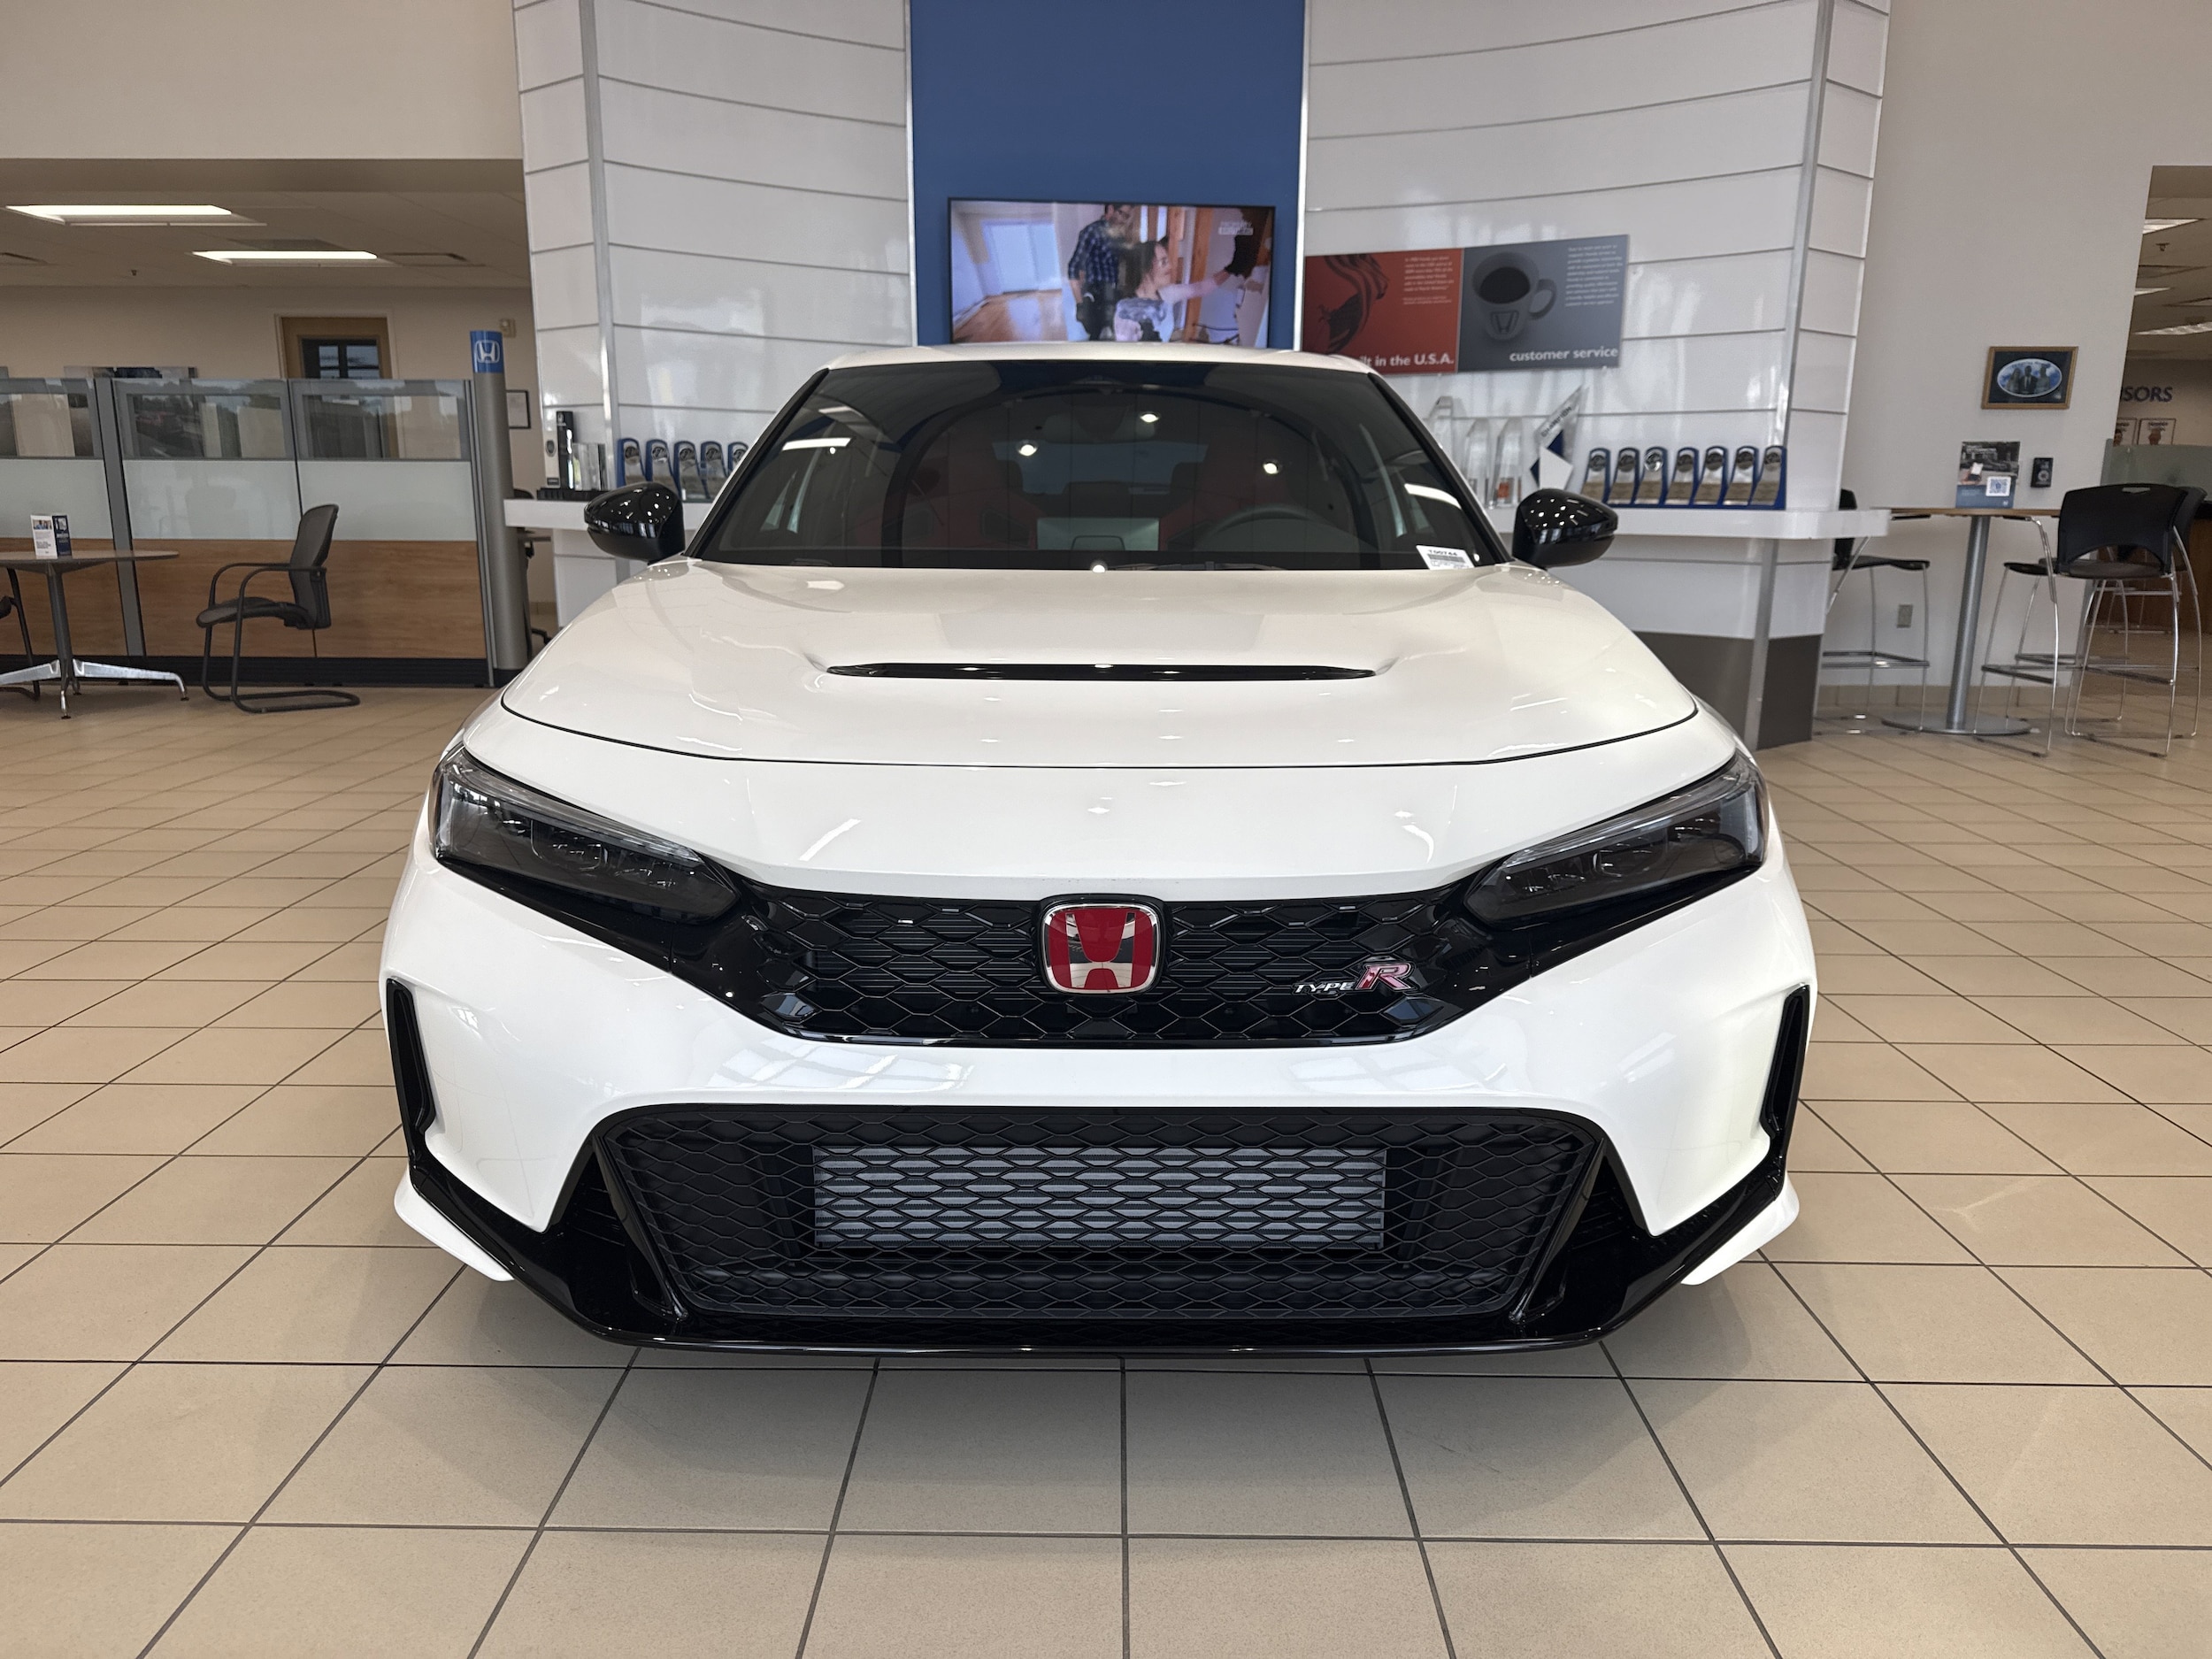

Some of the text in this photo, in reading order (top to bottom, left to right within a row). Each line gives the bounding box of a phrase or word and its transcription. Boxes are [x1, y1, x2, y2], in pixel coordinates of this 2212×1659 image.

[1375, 355, 1386, 366] in
[1390, 355, 1410, 366] the
[1414, 354, 1454, 365] U.S.A.
[1509, 346, 1618, 362] customer service
[1294, 963, 1413, 993] TYPE R
